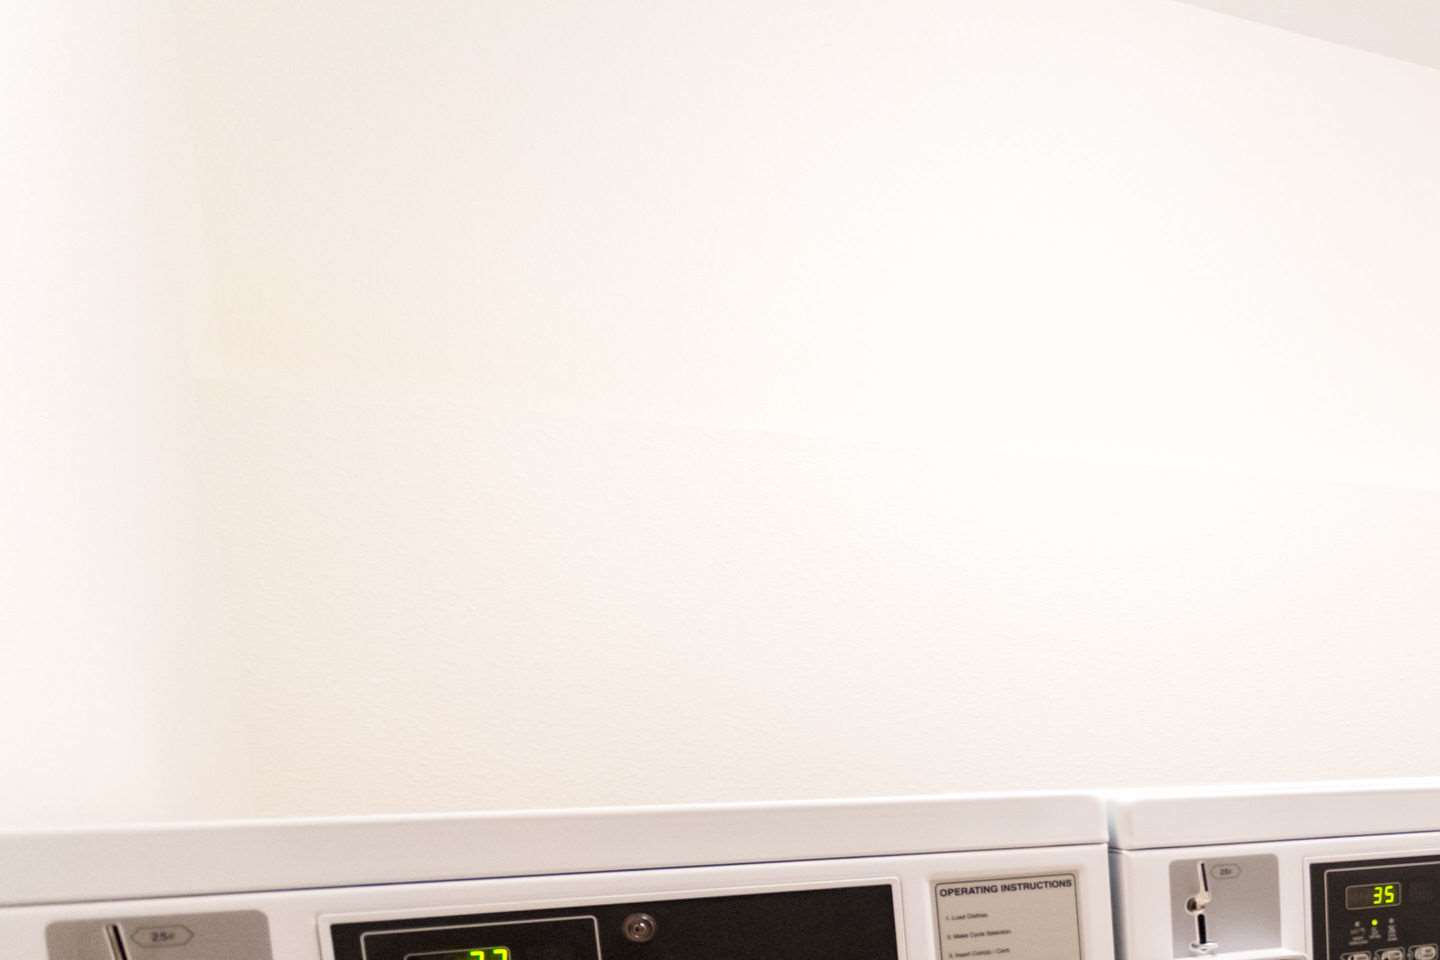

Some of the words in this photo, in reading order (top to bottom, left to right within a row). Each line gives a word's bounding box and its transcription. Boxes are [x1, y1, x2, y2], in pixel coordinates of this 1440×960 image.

[939, 885, 999, 898] OPERATING
[1000, 879, 1073, 892] INSTRUCTIONS
[1373, 885, 1395, 905] 35
